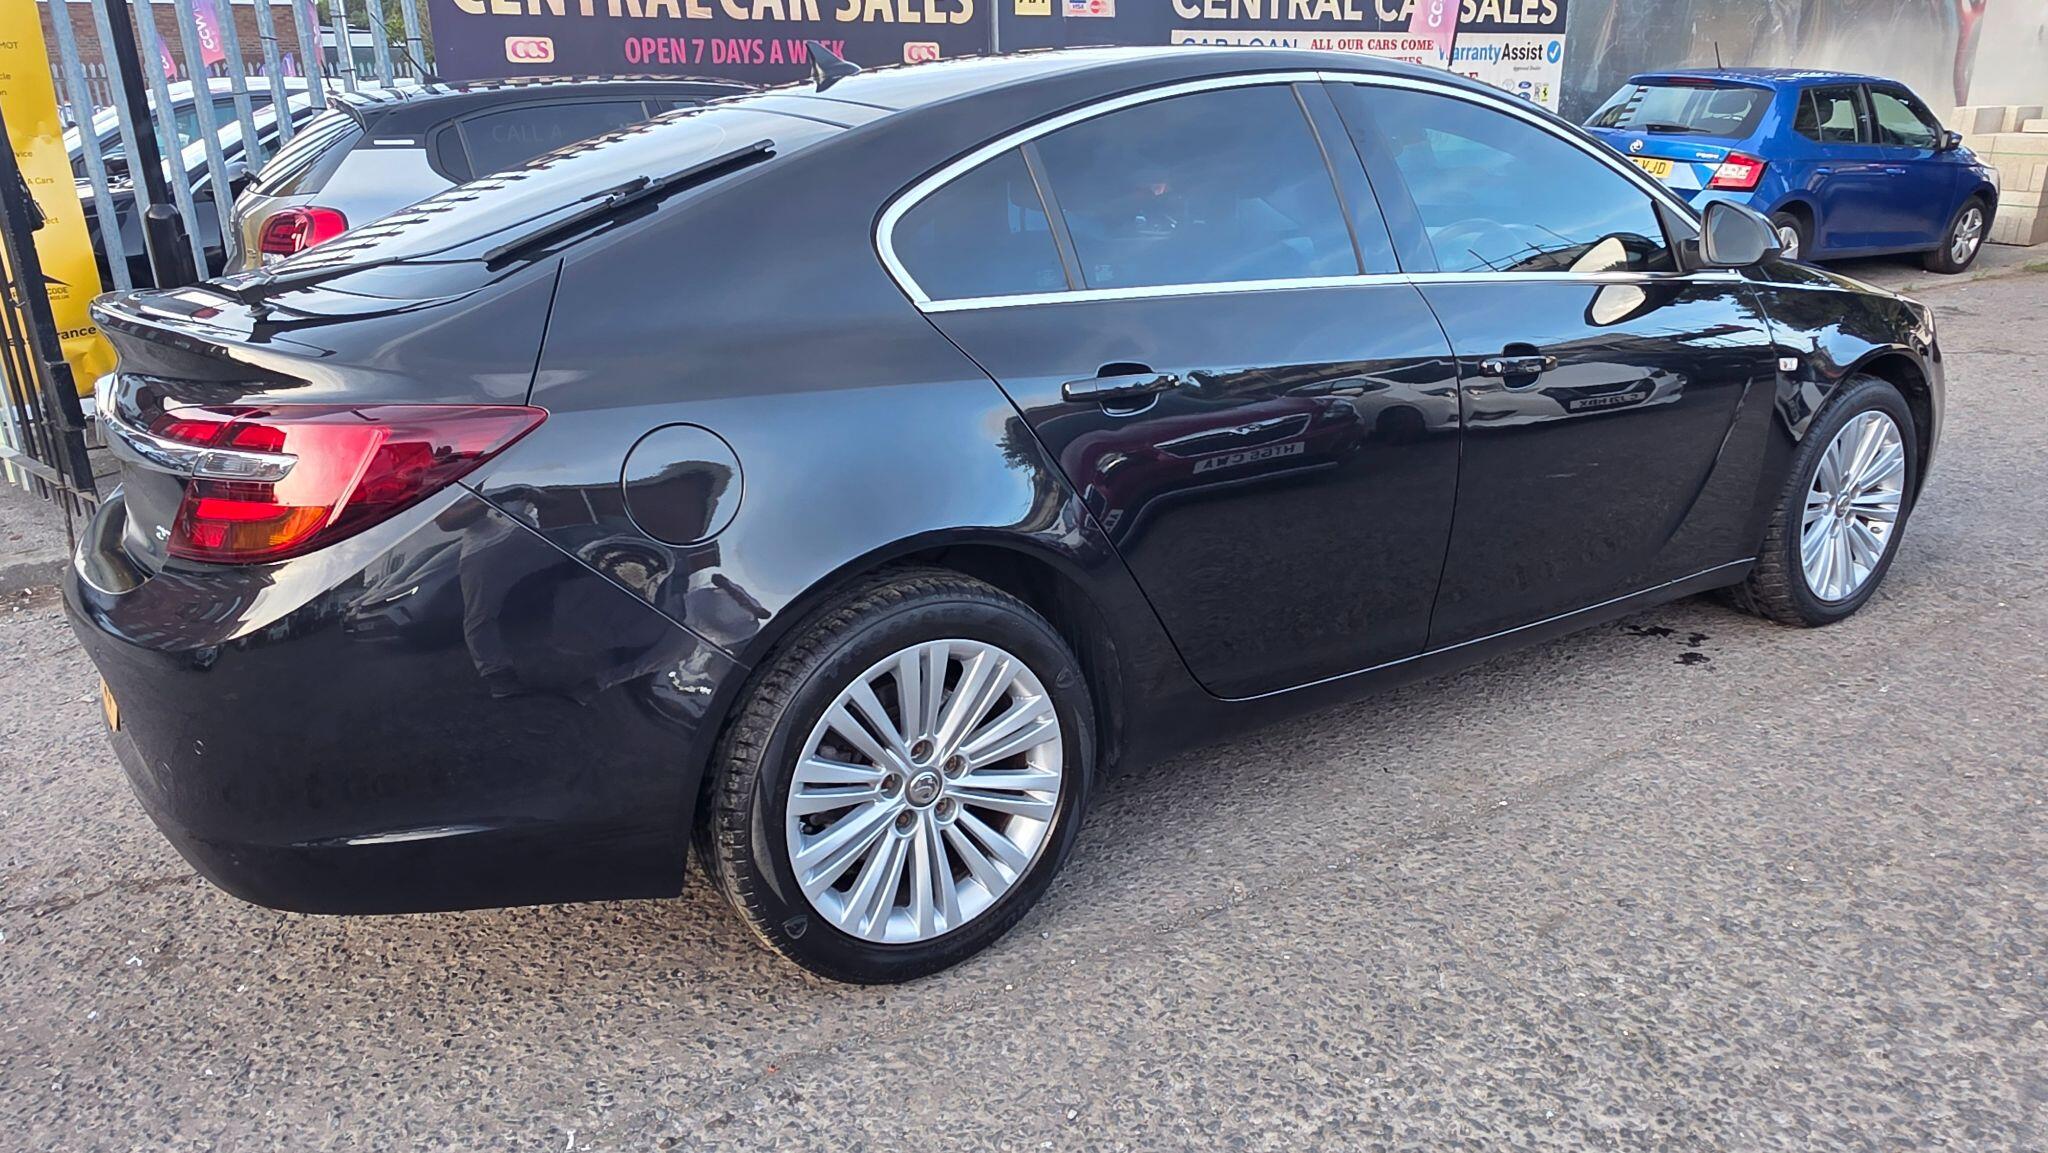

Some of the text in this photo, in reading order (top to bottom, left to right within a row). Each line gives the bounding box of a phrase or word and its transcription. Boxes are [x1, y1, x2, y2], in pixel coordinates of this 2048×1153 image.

[625, 37, 845, 65] OPEN 7 DAYS A WK
[1311, 39, 1434, 51] ALL OUR CARS COME
[492, 123, 545, 142] CALL
[1642, 160, 1666, 174] VJD
